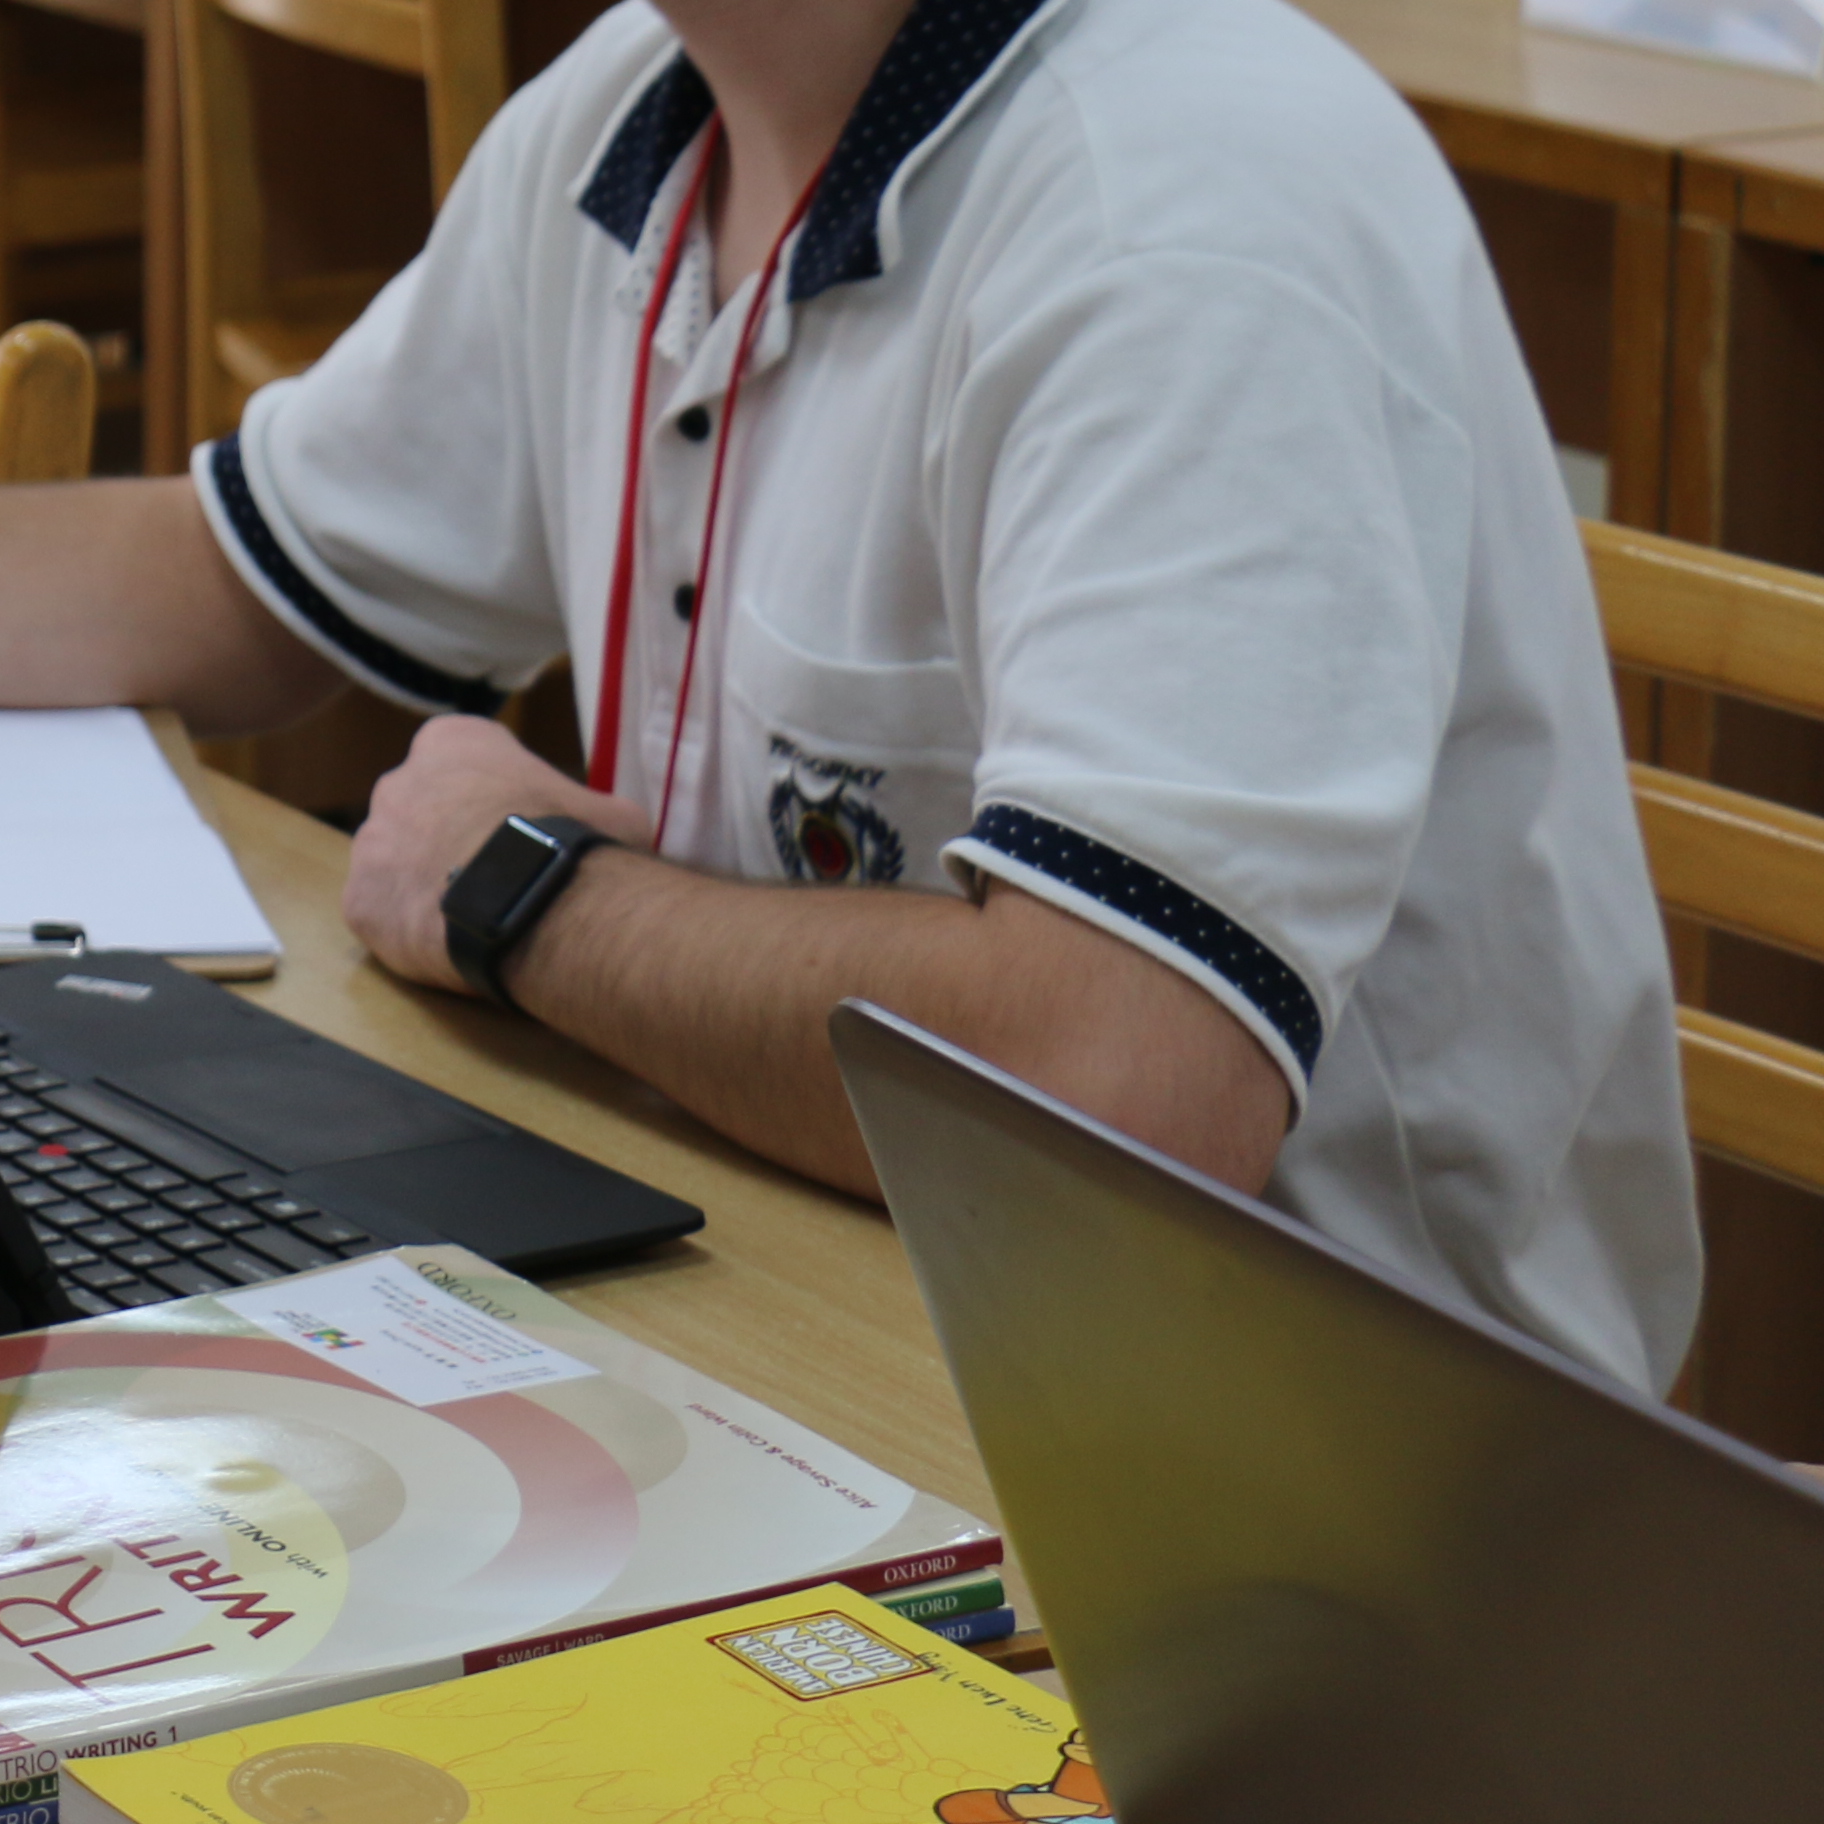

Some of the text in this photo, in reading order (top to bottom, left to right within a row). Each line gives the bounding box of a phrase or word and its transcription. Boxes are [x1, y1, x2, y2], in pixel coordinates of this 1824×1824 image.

[780, 1454, 838, 1488] Savage
[285, 1552, 329, 1578] with
[884, 1554, 957, 1583] OXFORD
[496, 1645, 551, 1668] SAVAGE
[758, 1625, 879, 1687] BORN
[804, 1617, 914, 1673] CHINESE
[725, 1634, 833, 1694] AMERICAN
[65, 1730, 157, 1759] WRITING
[167, 1726, 178, 1743] 1
